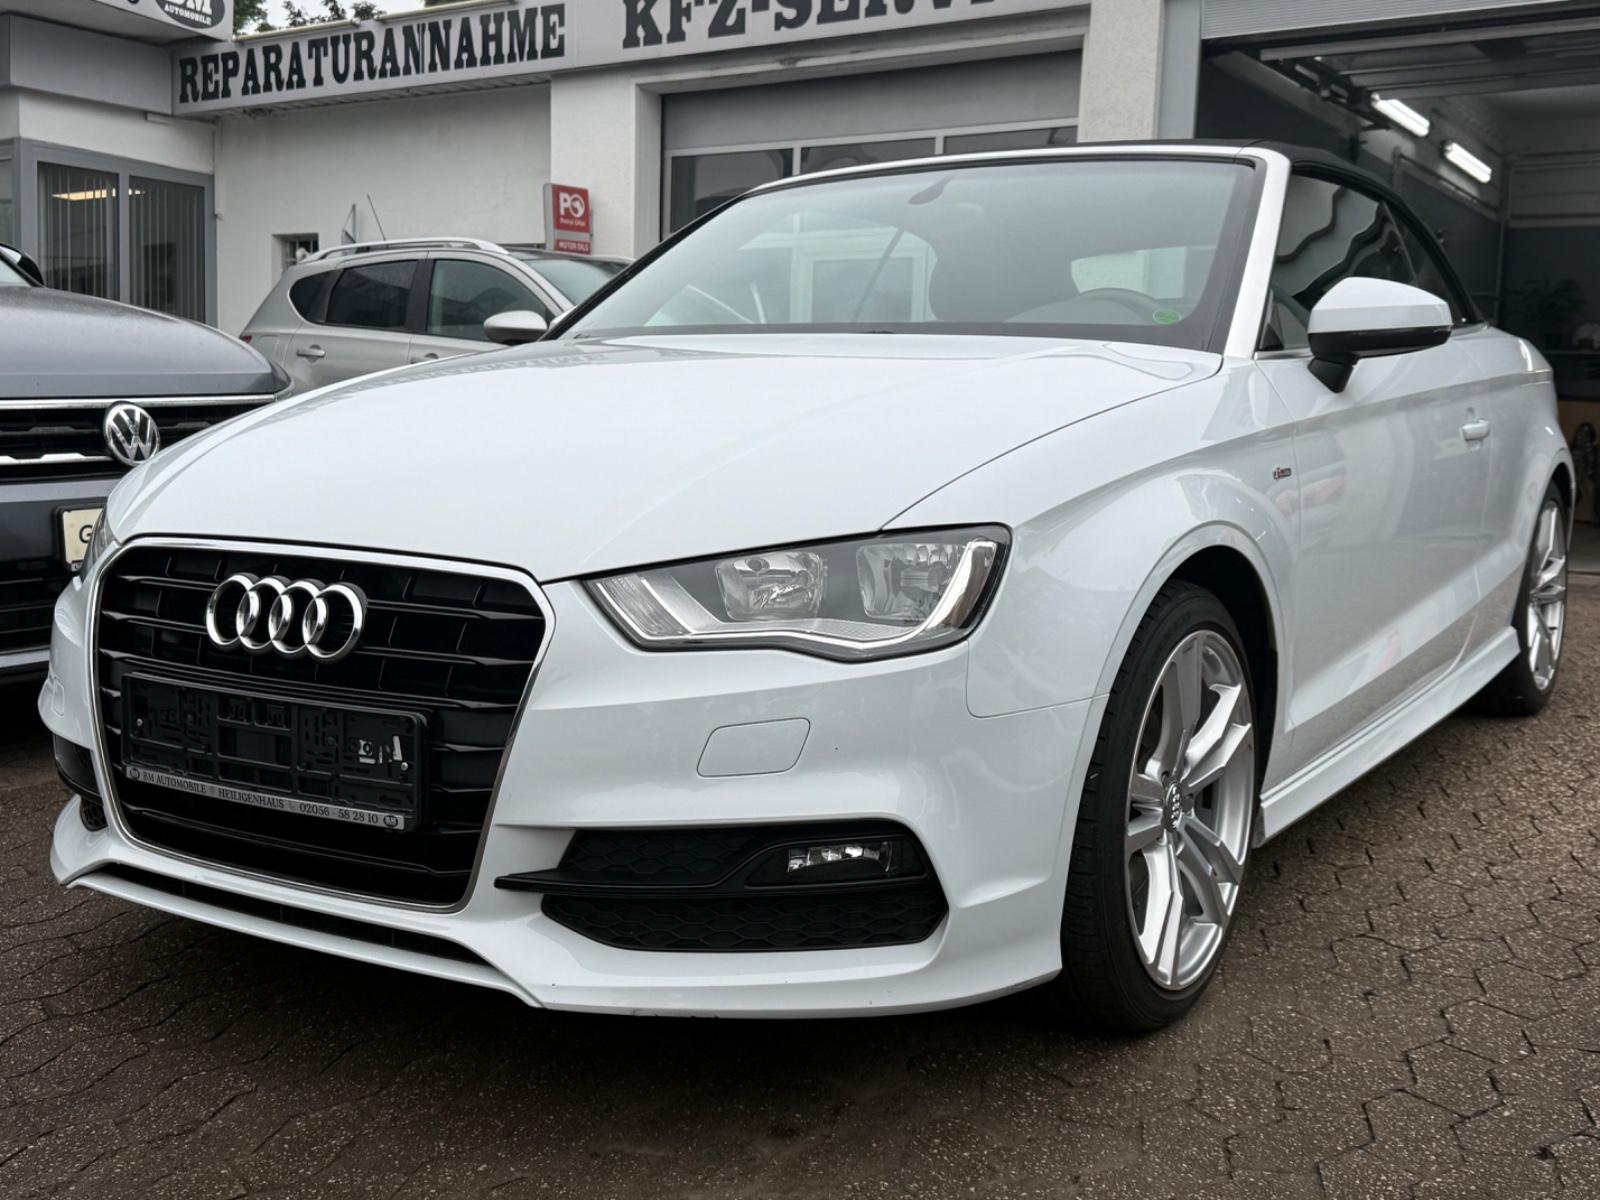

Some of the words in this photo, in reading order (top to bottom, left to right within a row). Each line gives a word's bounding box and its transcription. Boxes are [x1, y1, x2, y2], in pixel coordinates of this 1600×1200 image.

[164, 3, 212, 25] AUTOMOBILE
[179, 3, 565, 104] REPARATURANNAHME
[156, 774, 207, 794] AUTOMOBILE
[218, 788, 285, 809] HEILIGENHAUS
[299, 803, 330, 817] 02056
